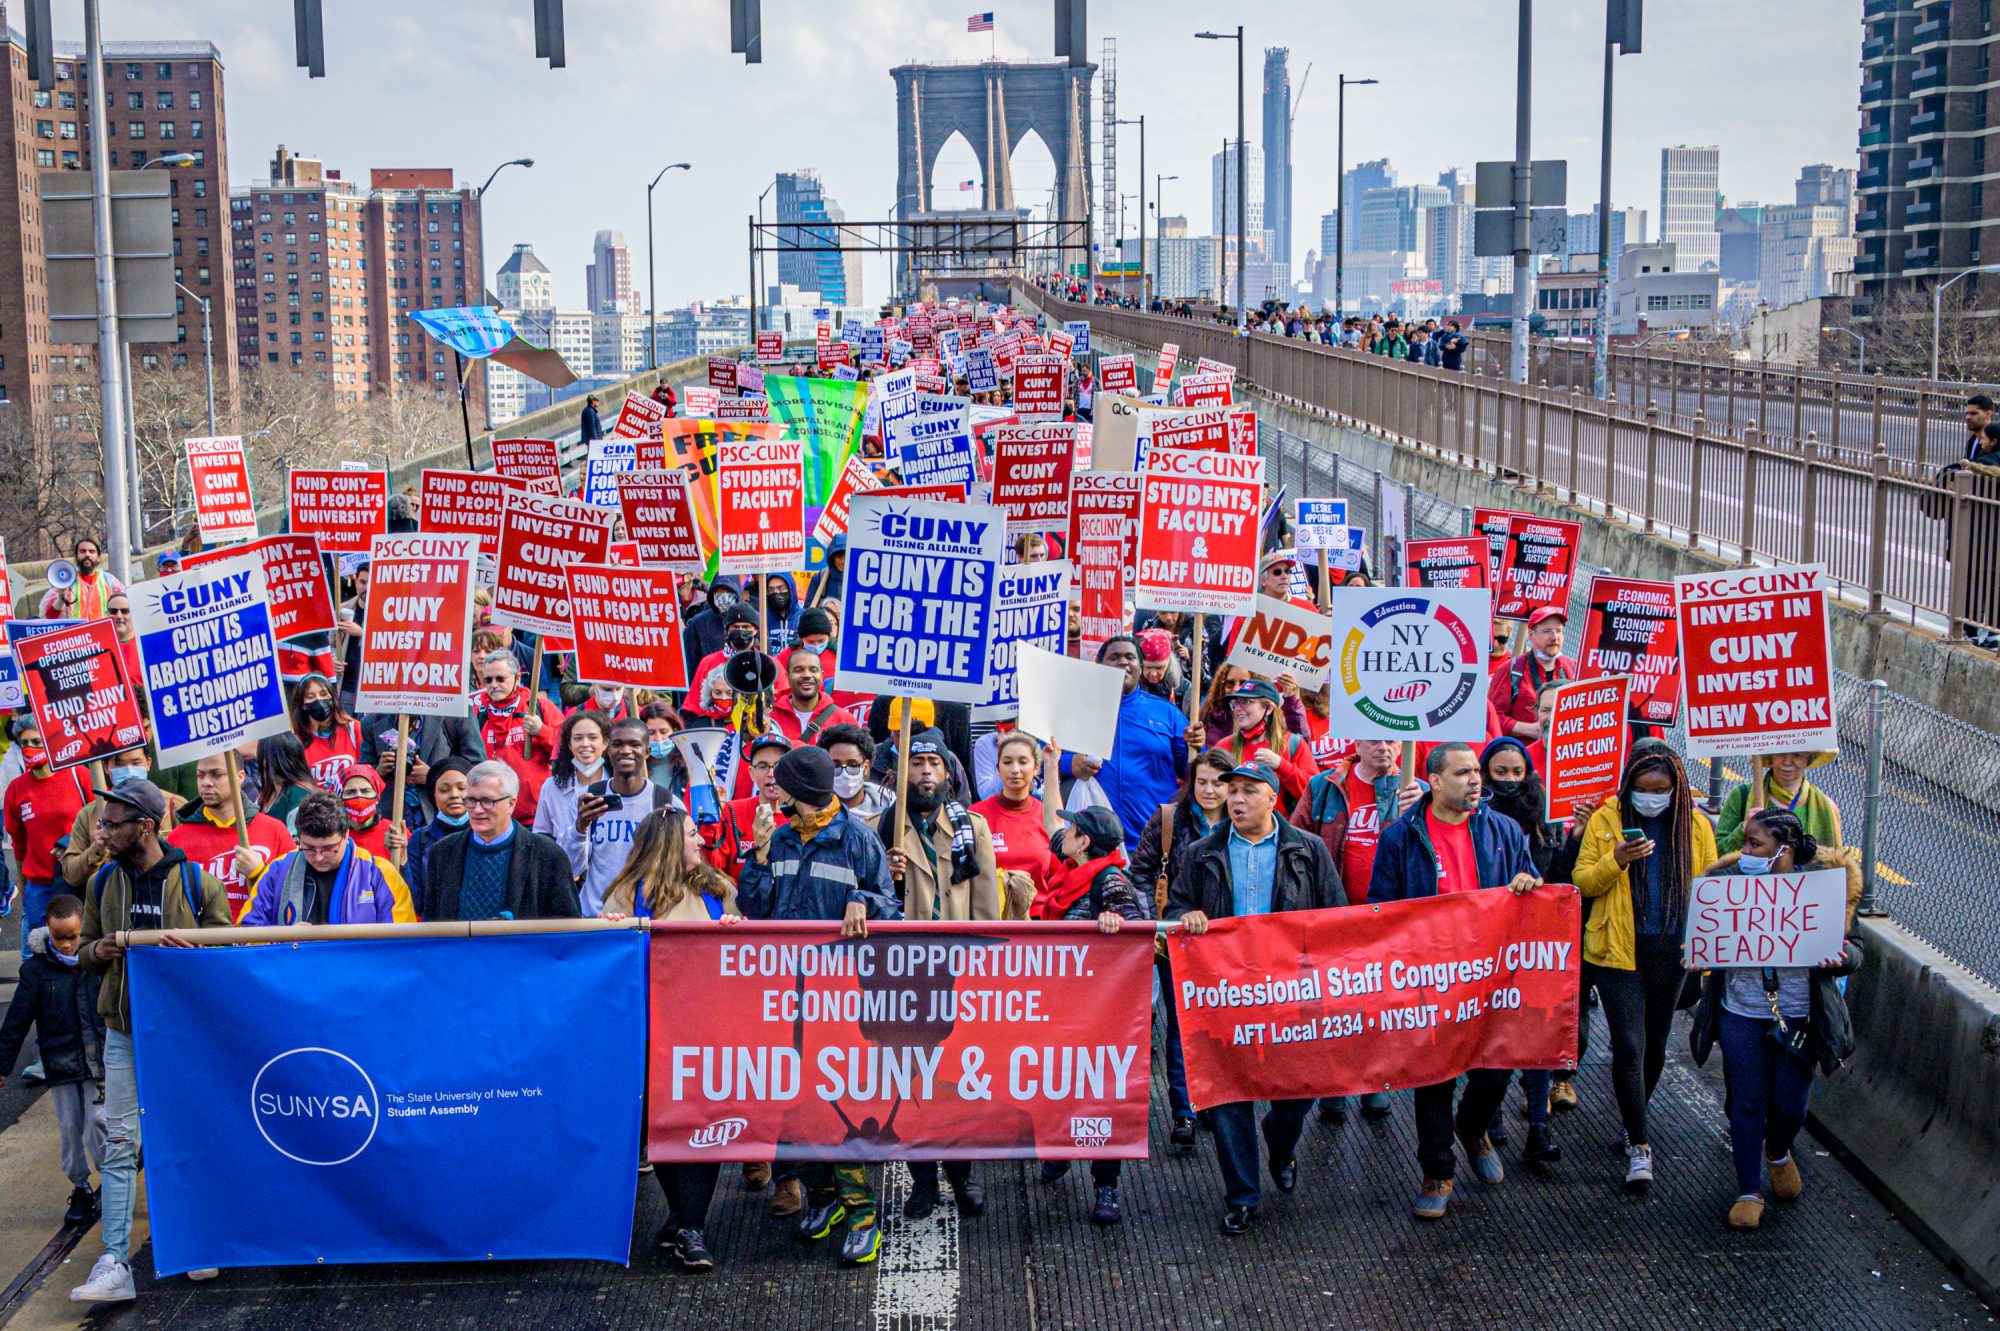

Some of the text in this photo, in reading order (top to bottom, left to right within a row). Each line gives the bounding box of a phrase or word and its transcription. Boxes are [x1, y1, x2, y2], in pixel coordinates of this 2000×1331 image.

[972, 377, 995, 388] PEOPLE
[1019, 366, 1058, 374] INVEST IN
[1024, 378, 1052, 388] CUNY
[1015, 402, 1060, 411] NEW YORK
[720, 443, 800, 462] PSC-CUNY
[1148, 451, 1261, 480] PSC-CUNY
[722, 469, 801, 489] STUDENTS,
[732, 489, 793, 509] FACULTY
[1146, 481, 1258, 516] STUDENTS,
[759, 511, 770, 529] &
[881, 512, 988, 546] CUNY
[1157, 509, 1247, 536] FACULTY
[1527, 524, 1563, 536] ECONOMIC
[373, 539, 471, 558] PSC-CUNY
[722, 531, 802, 552] STAFF UNITED
[883, 538, 983, 555] RISING ALLIANCE
[1191, 536, 1208, 558] &
[1519, 532, 1567, 546] OPPORTUNITY.
[1523, 544, 1559, 557] ECONOMIC
[1524, 554, 1553, 565] JUSTICE.
[375, 563, 459, 584] INVEST IN
[573, 575, 609, 594] FUND
[856, 550, 985, 598] CUNY IS
[1140, 558, 1253, 588] STAFF UNITED
[1506, 568, 1568, 588] FUND SUNY
[1681, 571, 1819, 600] PSC-CUNY
[160, 570, 252, 615] CUNY
[1514, 585, 1555, 601] & CUNY
[1618, 589, 1670, 605] ECONOMIC
[168, 593, 254, 624] RISING ALLIANCE
[382, 596, 445, 622] CUNY
[574, 598, 675, 623] THE PEOPLE'S
[852, 592, 982, 638] FOR THE
[1374, 602, 1416, 618] Education
[1607, 600, 1677, 618] OPPORTUNITY.
[1690, 599, 1811, 627] INVEST IN
[172, 612, 242, 656] CUNY IS
[584, 623, 670, 646] UNIVERSITY
[1391, 625, 1429, 645] NY
[1449, 621, 1468, 645] Access
[1613, 617, 1665, 633] ECONOMIC
[1615, 630, 1657, 645] JUSTICE.
[43, 632, 93, 656] ECONOMIC
[371, 631, 452, 651] INVEST IN
[1710, 632, 1798, 664] CUNY
[38, 642, 105, 667] OPPORTUNITY.
[149, 633, 272, 692] ABOUT RACIAL
[604, 655, 654, 673] PSC-CUNY
[855, 632, 972, 678] PEOPLE
[1244, 645, 1320, 675] NEW DEAL 4 CUNY
[1344, 640, 1356, 684] Healthcare
[1362, 651, 1454, 673] HEALS
[1588, 649, 1679, 676] FUND SUNY
[50, 659, 100, 681] ECONOMIC
[58, 671, 98, 692] JUSTICE.
[362, 662, 460, 687] NEW YORK
[1697, 667, 1814, 694] INVEST IN
[162, 663, 269, 717] & ECONOMIC
[888, 678, 932, 690] #CUNYrising
[1384, 679, 1432, 702] uup
[42, 683, 126, 723] FUND SUNY
[1438, 682, 1471, 717] Leadership
[1559, 687, 1620, 712] SAVE LIVES.
[62, 705, 118, 737] & CUNY
[188, 697, 256, 740] JUSTICE
[1362, 702, 1414, 728] Sustainability
[1557, 711, 1618, 736] SAVE JOBS.
[1689, 697, 1828, 730] NEW YORK
[206, 728, 244, 747] #CUNYrising
[1556, 736, 1618, 762] SAVE CUNY.
[1698, 736, 1742, 744] Professional
[1696, 874, 1806, 906] CUNY
[1696, 904, 1819, 933] STRIKE
[720, 943, 1094, 978] ECONOMIC OPPORTUNITY.
[1691, 933, 1800, 964] READY
[1181, 969, 1322, 1011] Professional
[1327, 962, 1383, 998] Staff
[763, 989, 1050, 1023] ECONOMIC JUSTICE.
[1233, 1023, 1265, 1046] AFT
[1271, 1018, 1317, 1044] Local
[1322, 1015, 1363, 1038] 2334
[1379, 1004, 1438, 1032] NYSUT
[672, 1045, 1138, 1101] FUND SUNY & CUNY
[259, 1092, 372, 1119] SUNYSA
[386, 1086, 543, 1103] The State University of New York
[387, 1104, 479, 1118] Student Assembly
[688, 1117, 749, 1149] uup
[1071, 1116, 1112, 1138] PSC
[1074, 1137, 1108, 1147] CUNY
